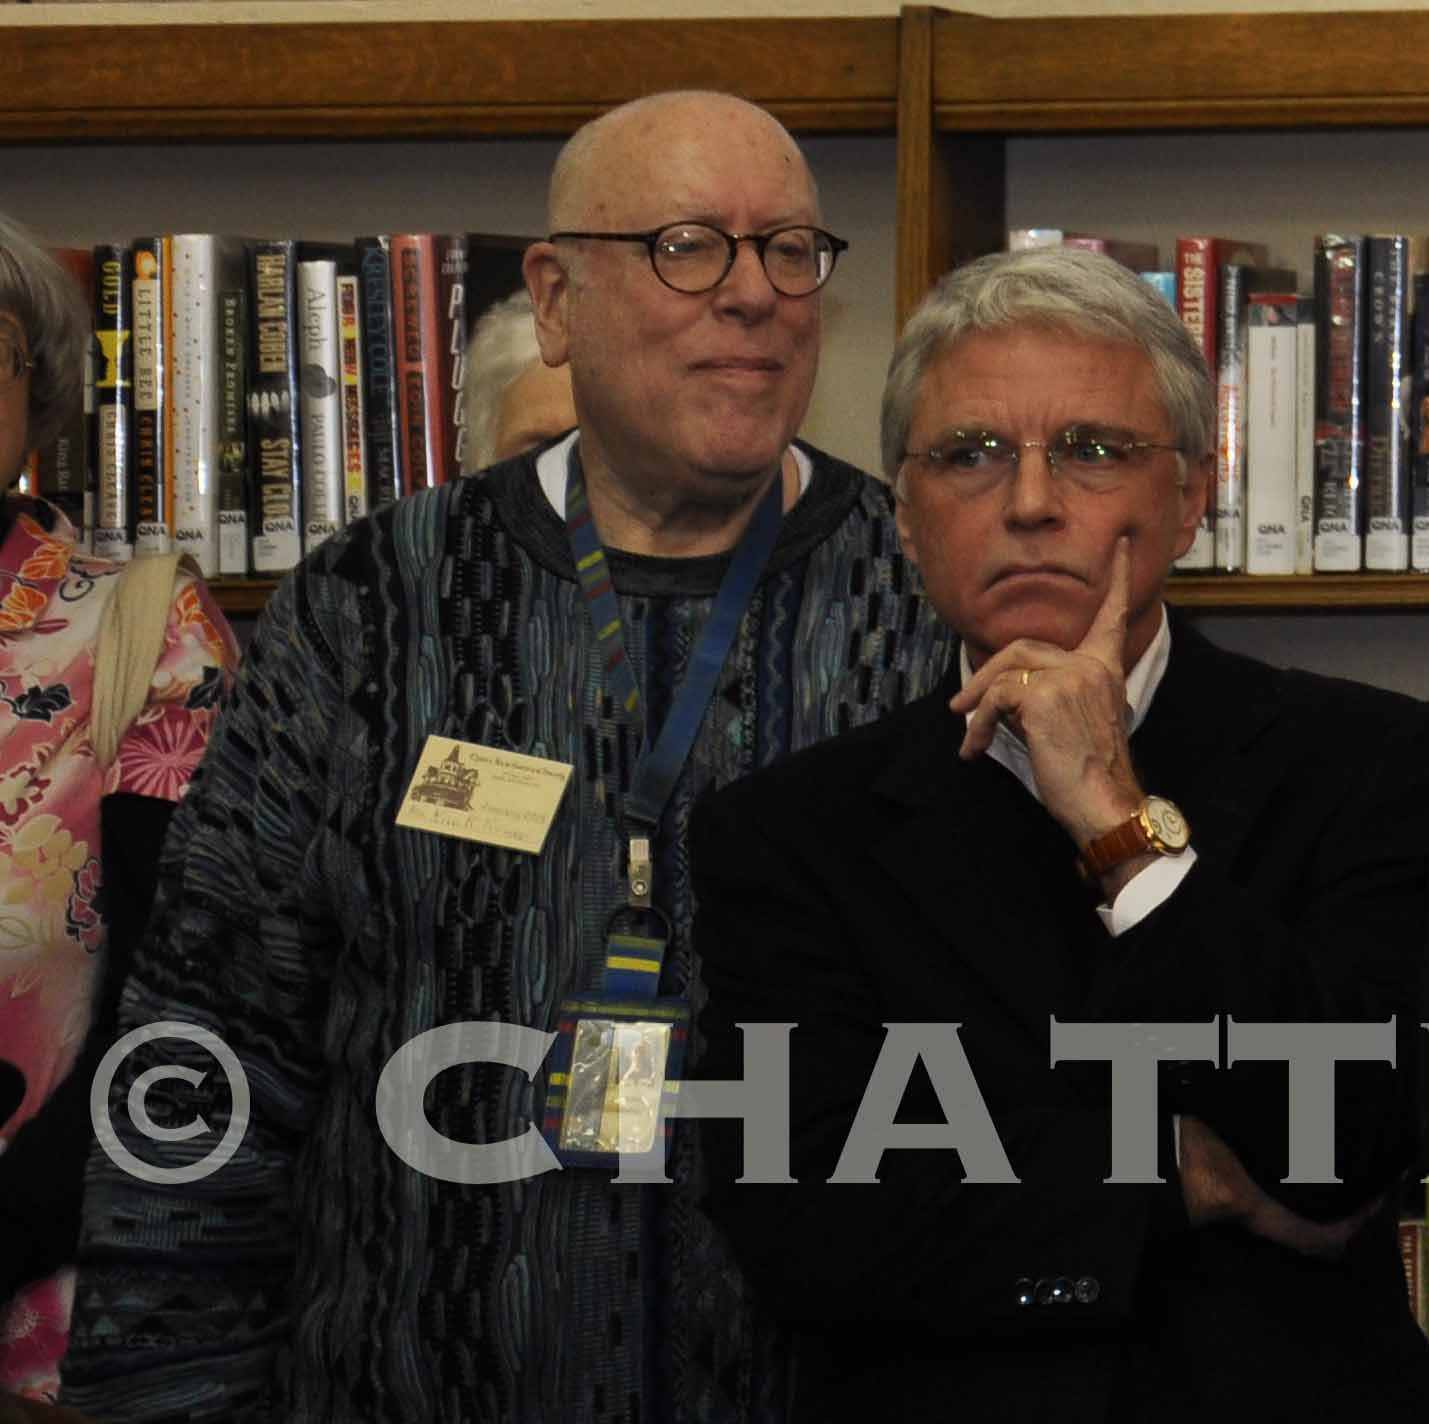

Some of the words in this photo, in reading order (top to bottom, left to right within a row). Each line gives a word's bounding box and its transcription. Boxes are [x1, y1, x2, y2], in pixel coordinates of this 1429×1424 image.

[102, 261, 120, 316] GOLD
[256, 254, 287, 318] HARLAN
[341, 282, 356, 327] FOUR
[365, 247, 388, 337] KRESLEY
[1373, 270, 1385, 344] CROWN
[138, 288, 152, 356] LITTLE
[224, 297, 237, 356] BROKEN
[259, 323, 287, 373] COBEN
[302, 287, 328, 352] Aleph
[370, 343, 389, 393] COLE
[449, 283, 466, 463] PLUGG
[139, 416, 154, 467] CHRIS
[261, 438, 290, 478] STAY
[139, 474, 154, 522] CLEA
